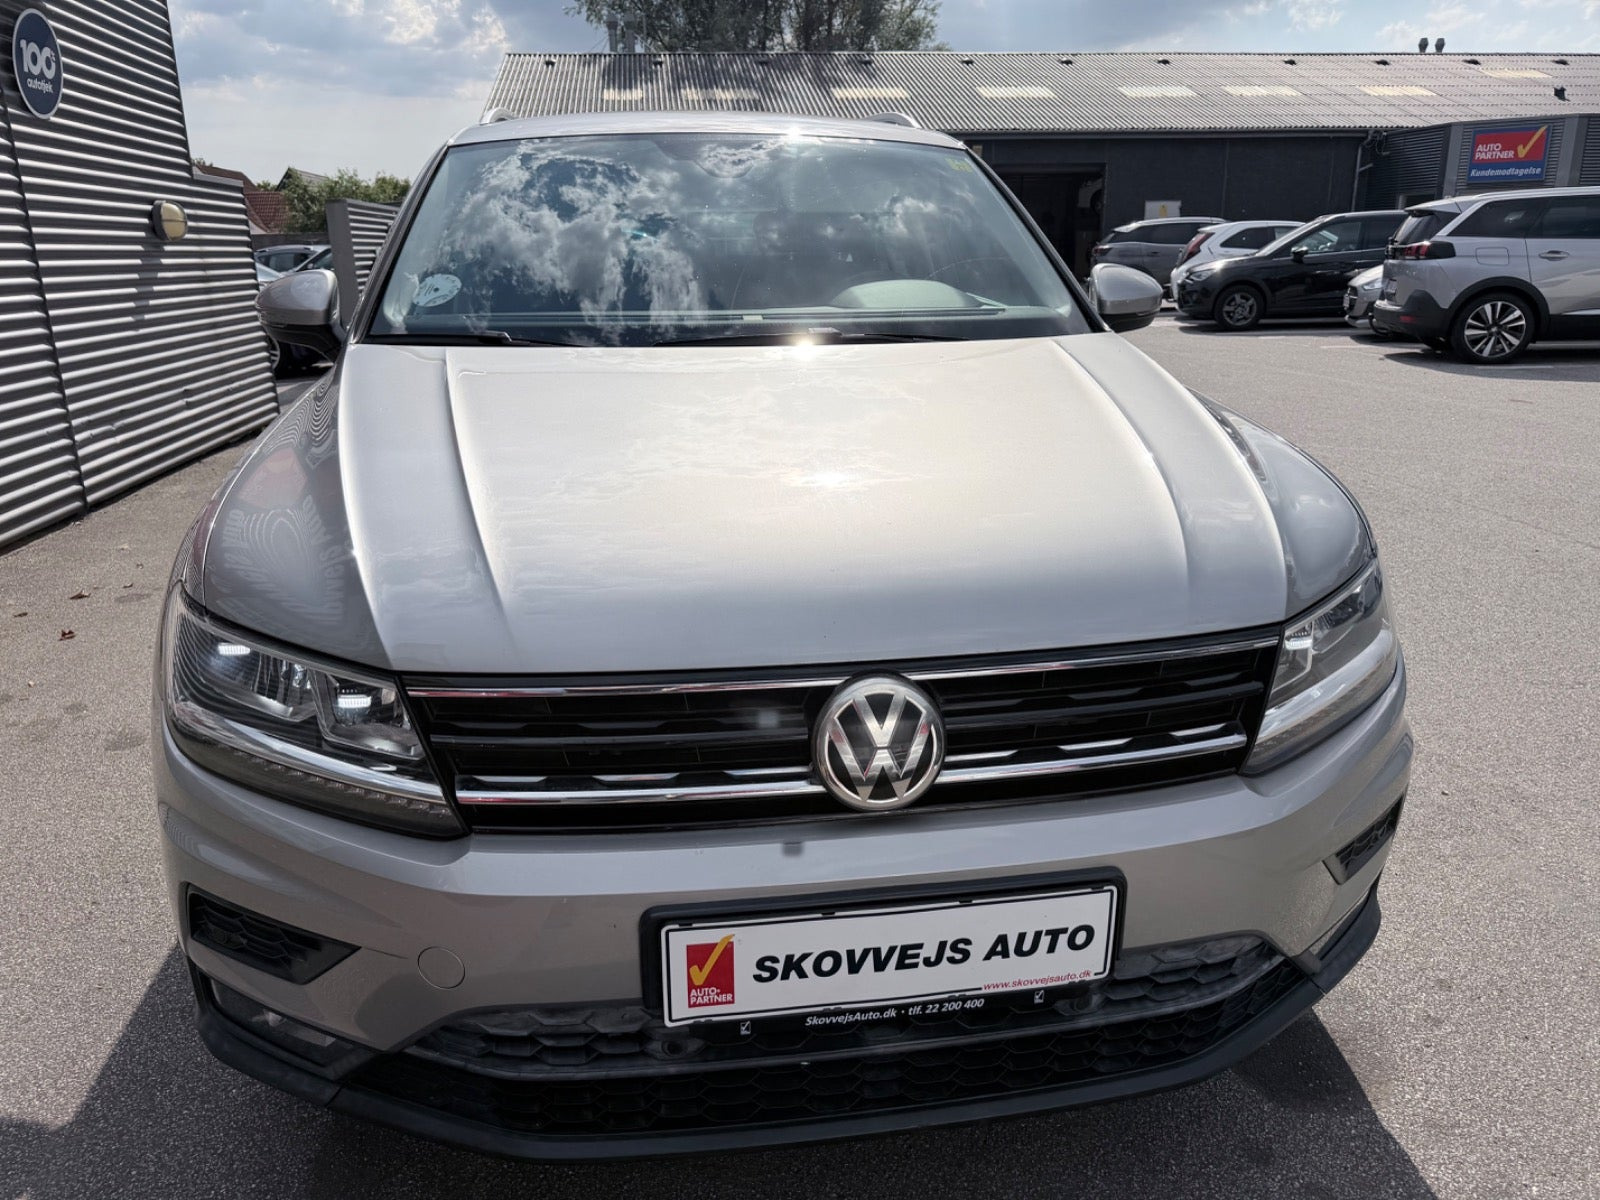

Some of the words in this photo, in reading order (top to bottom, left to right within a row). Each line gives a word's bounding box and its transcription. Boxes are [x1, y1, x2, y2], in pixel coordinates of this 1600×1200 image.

[1476, 143, 1502, 152] AUTO
[1475, 150, 1515, 160] PARTNER
[1470, 166, 1542, 177] Kundemodtagelse
[752, 937, 973, 983] SKOVVEJS
[982, 924, 1096, 962] AUTO
[983, 969, 1093, 991] www.skovvejsauto.dk
[690, 993, 734, 1005] PARTNER
[805, 1007, 898, 1026] SkovvejsAuto.dk
[908, 1005, 923, 1016] tlf.
[925, 1003, 939, 1014] 22
[941, 1000, 962, 1012] 200
[963, 998, 985, 1010] 400
